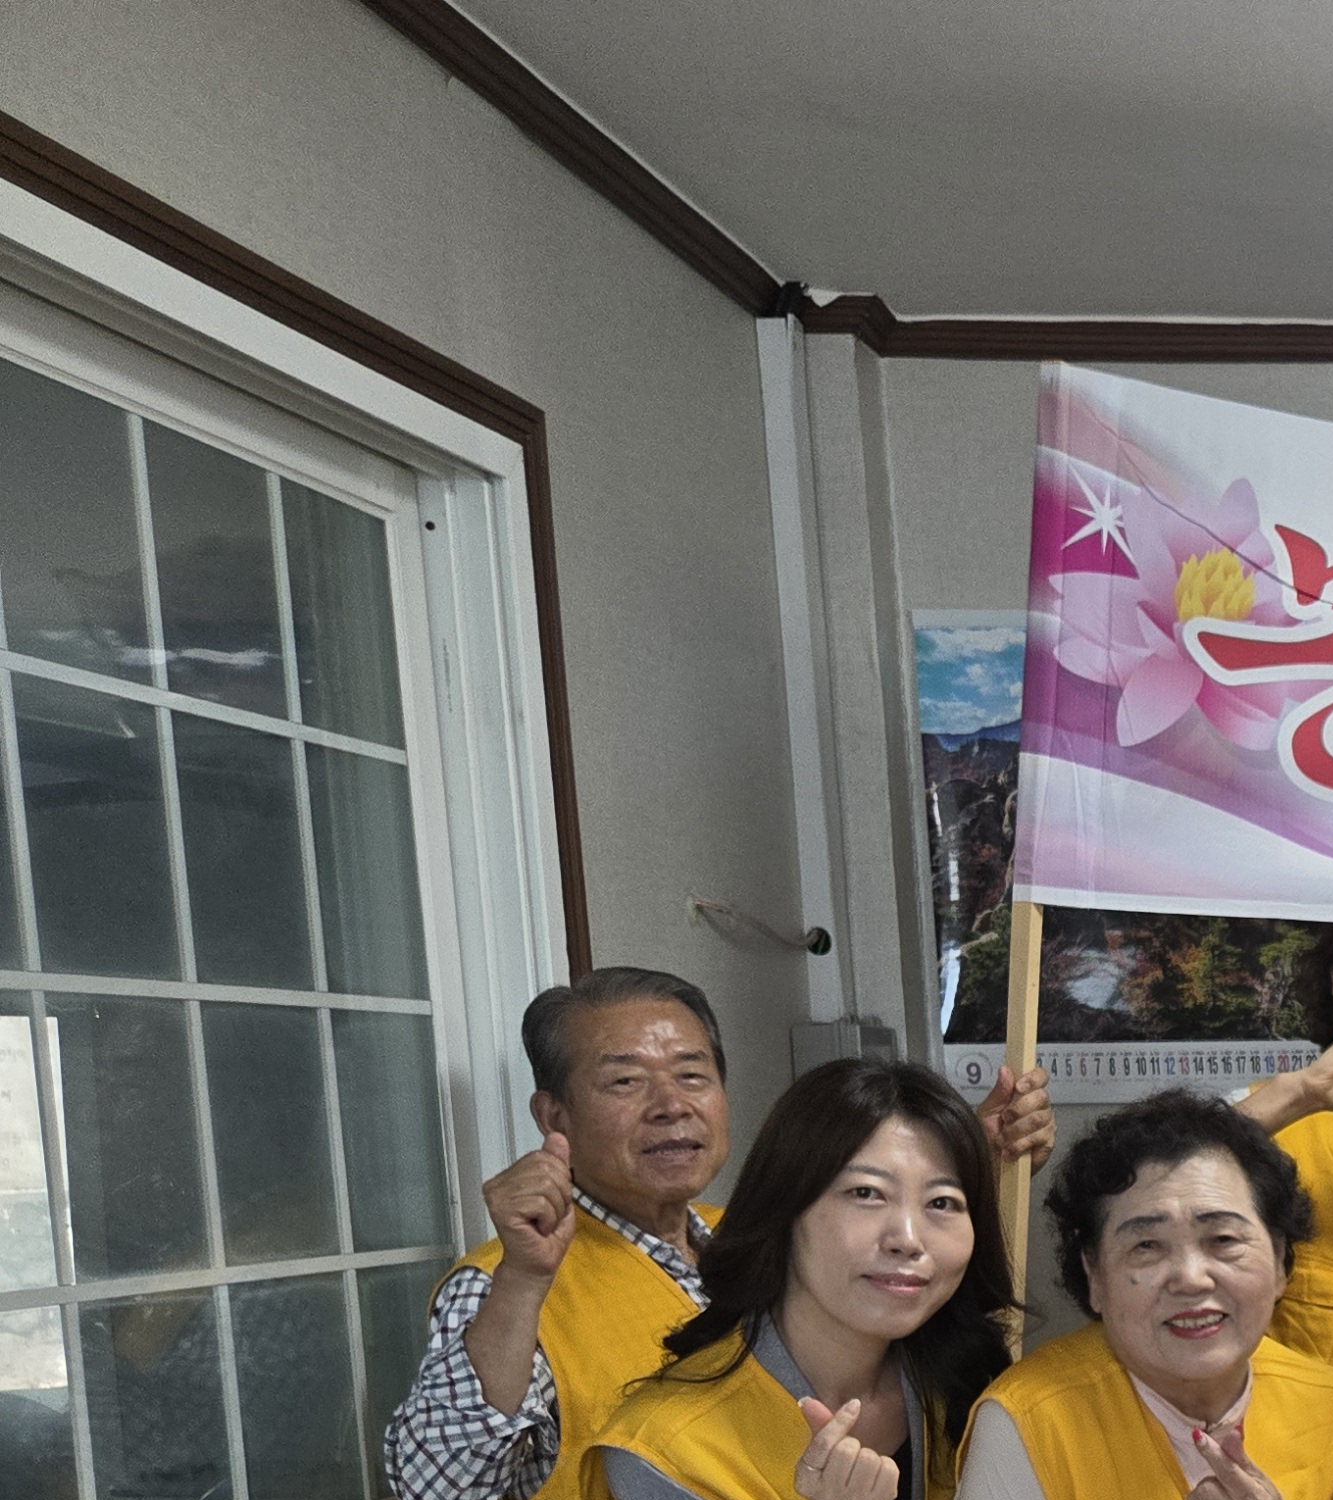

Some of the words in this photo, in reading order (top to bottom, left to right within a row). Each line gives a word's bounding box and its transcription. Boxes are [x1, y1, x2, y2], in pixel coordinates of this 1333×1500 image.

[966, 1062, 982, 1085] 9
[1051, 1058, 1057, 1076] 4
[1065, 1058, 1072, 1077] 5
[1080, 1058, 1087, 1077] 6
[1094, 1058, 1101, 1077] 7
[1109, 1058, 1116, 1077] 8
[1123, 1057, 1130, 1076] 9
[1135, 1057, 1147, 1076] 10
[1149, 1057, 1161, 1075] 11
[1164, 1057, 1176, 1076] 12
[1178, 1057, 1190, 1076] 13
[1193, 1056, 1204, 1076] 14
[1207, 1056, 1218, 1075] 15
[1221, 1056, 1233, 1075] 16
[1235, 1056, 1246, 1075] 17
[1250, 1055, 1261, 1075] 18
[1264, 1055, 1275, 1075] 19
[1277, 1055, 1290, 1074] 20
[1291, 1055, 1303, 1072] 21
